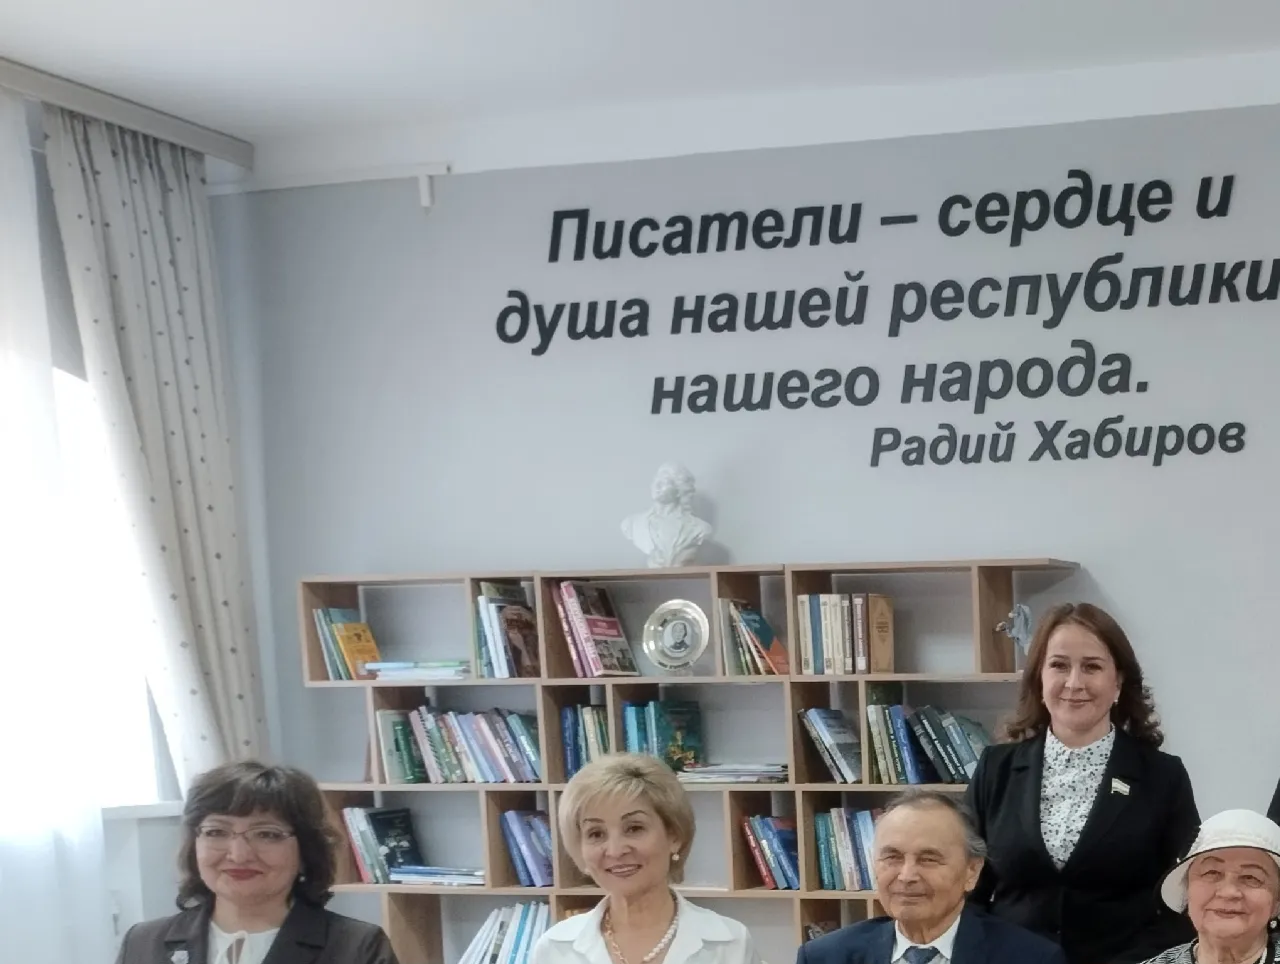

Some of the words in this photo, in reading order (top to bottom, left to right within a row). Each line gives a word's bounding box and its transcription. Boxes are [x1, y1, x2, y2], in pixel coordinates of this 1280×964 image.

[549, 203, 862, 262] Писатели
[937, 169, 1174, 247] сердце
[1195, 174, 1236, 220] и
[496, 289, 650, 356] душа
[670, 270, 869, 335] нашей
[651, 366, 880, 415] нашего
[900, 339, 1149, 415] народа.
[870, 421, 1017, 467] Радий
[1028, 414, 1246, 467] Хабиров
